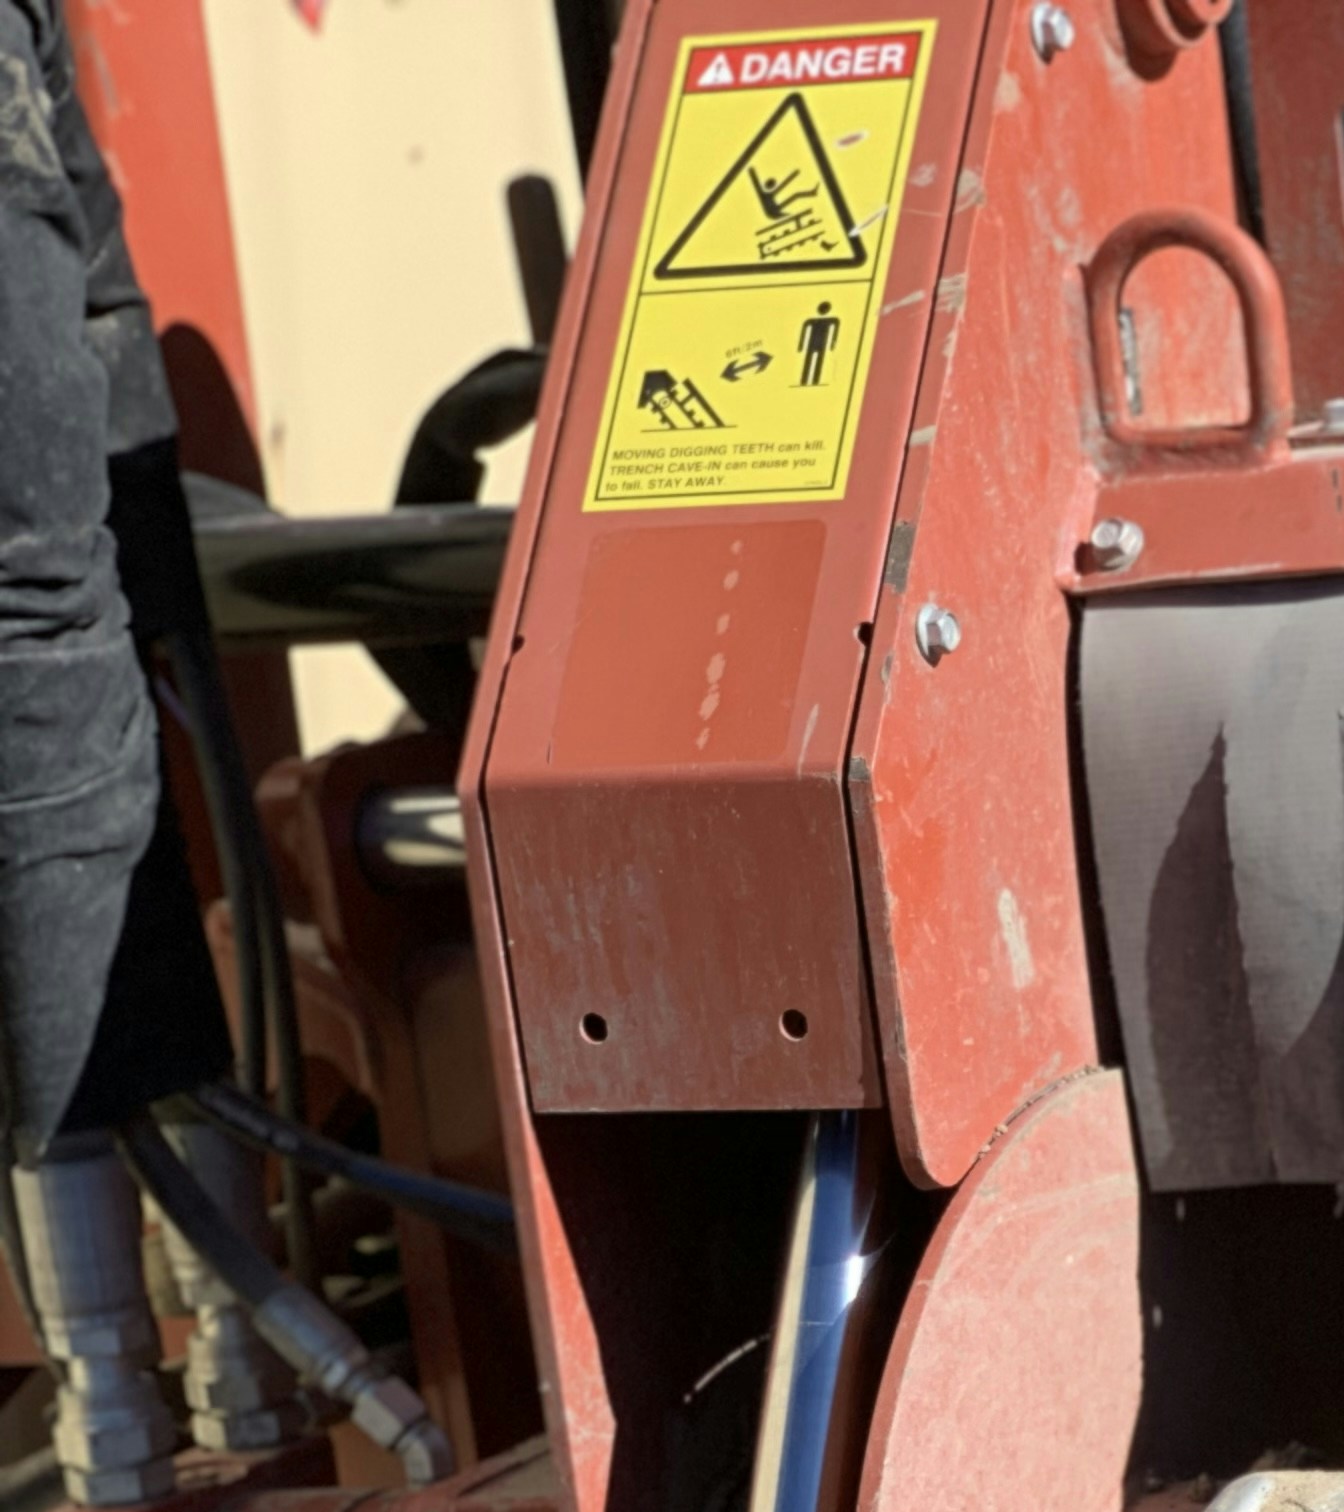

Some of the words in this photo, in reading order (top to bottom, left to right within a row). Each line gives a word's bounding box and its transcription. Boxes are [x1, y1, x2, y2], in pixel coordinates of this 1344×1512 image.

[739, 43, 907, 84] DANGER
[612, 449, 666, 461] MOVING
[669, 446, 727, 458] DIGGING
[732, 442, 774, 454] TEETH
[777, 442, 800, 453] can
[609, 464, 664, 476] TRENCH
[667, 461, 721, 474] CAVE-IN
[724, 461, 748, 471] can
[751, 459, 789, 469] cause
[792, 457, 816, 470] you
[605, 481, 618, 492] to
[647, 477, 682, 489] STAY
